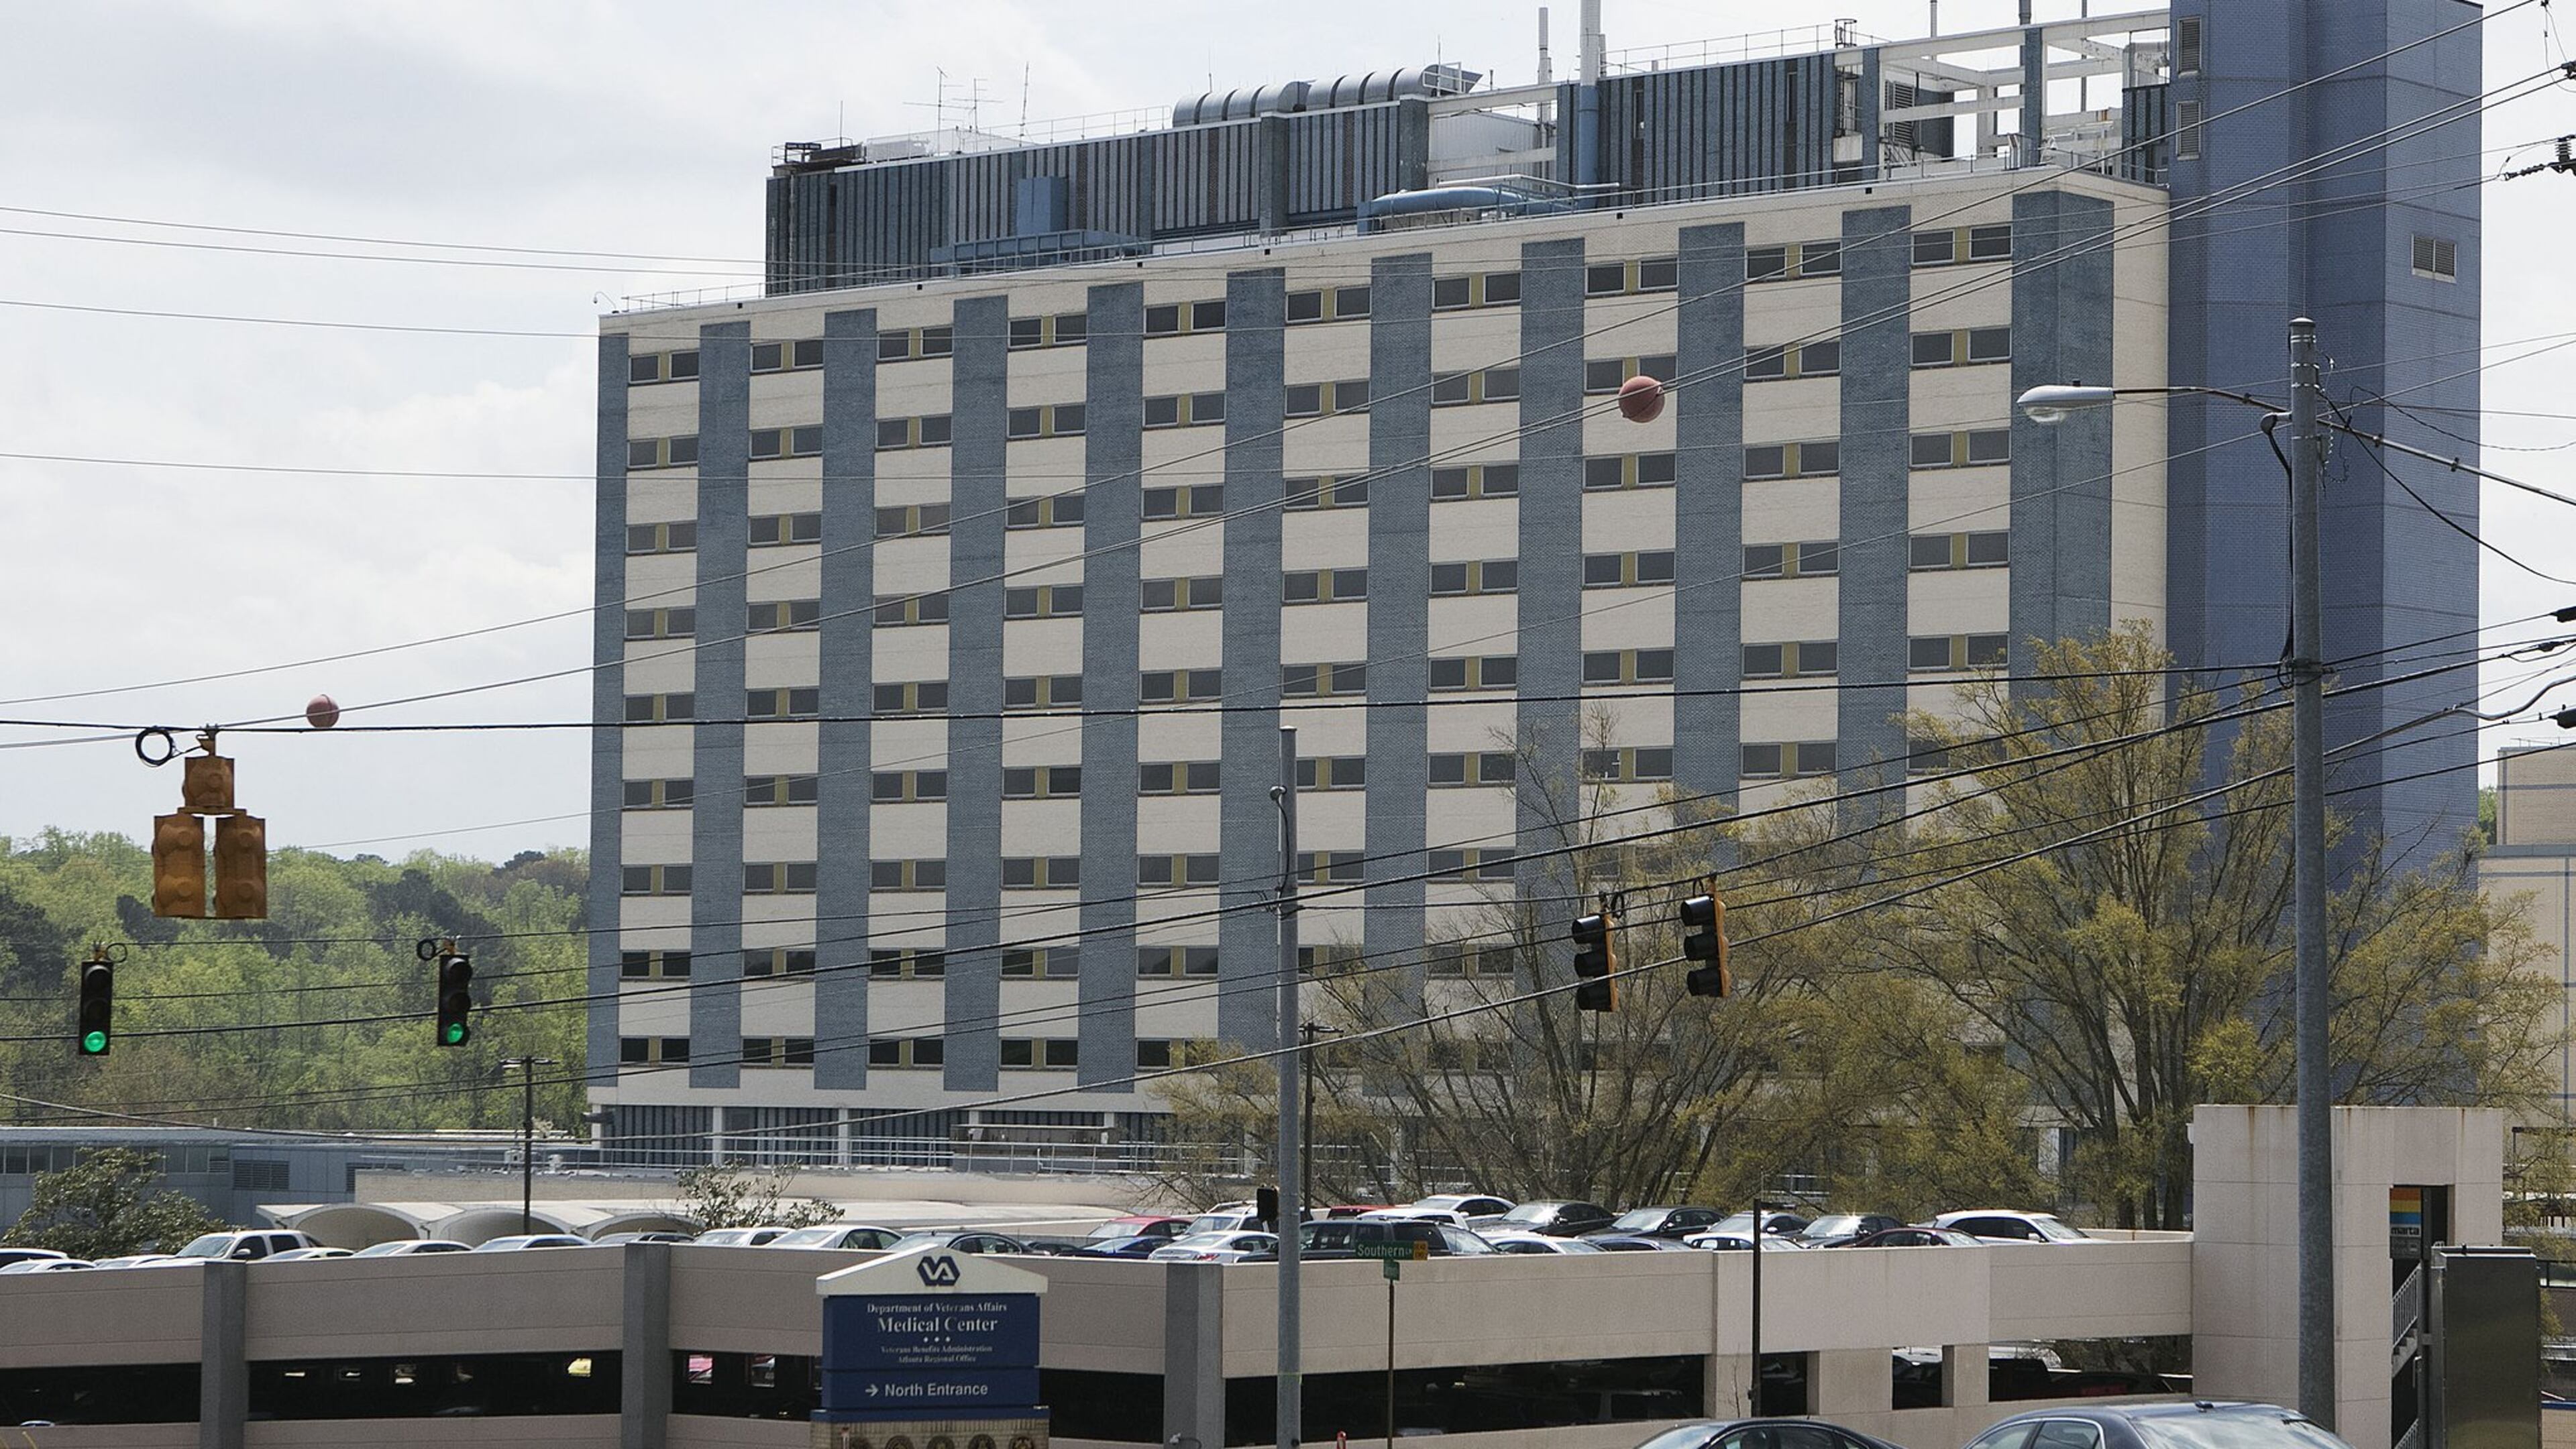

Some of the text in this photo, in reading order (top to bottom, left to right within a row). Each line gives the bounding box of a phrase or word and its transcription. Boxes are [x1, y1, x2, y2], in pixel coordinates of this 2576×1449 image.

[2391, 1227, 2419, 1235] marta
[1358, 1244, 1404, 1256] Southern
[918, 1260, 958, 1283] VA
[867, 1302, 1007, 1315] Department of Veterans Affairs
[877, 1317, 998, 1332] Medical Center
[912, 1345, 940, 1353] Benefits
[942, 1345, 992, 1353] Administration
[924, 1354, 954, 1364] Regional
[955, 1354, 976, 1362] Office
[885, 1383, 988, 1397] North Entrance
